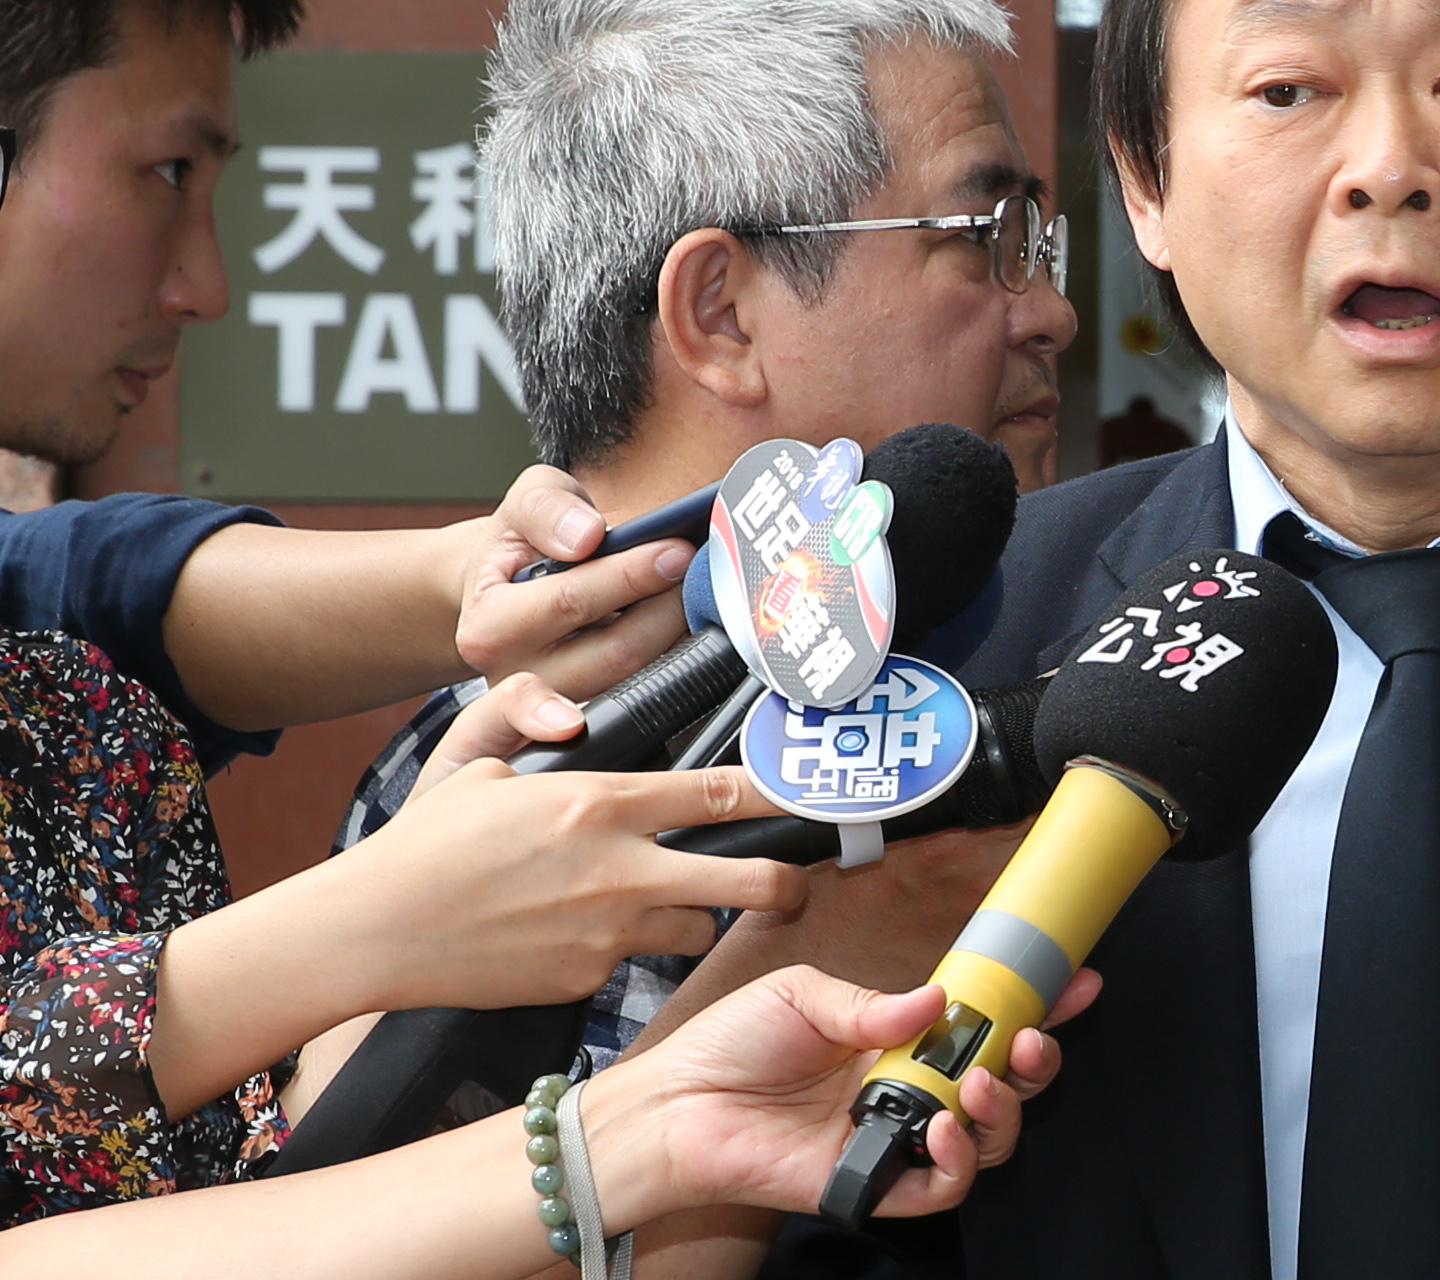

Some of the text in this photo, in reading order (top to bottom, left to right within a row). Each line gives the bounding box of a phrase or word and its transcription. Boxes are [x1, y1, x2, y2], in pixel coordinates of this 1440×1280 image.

[772, 449, 806, 491] 2018
[832, 486, 885, 561] CTS
[1075, 605, 1246, 693] 公視
